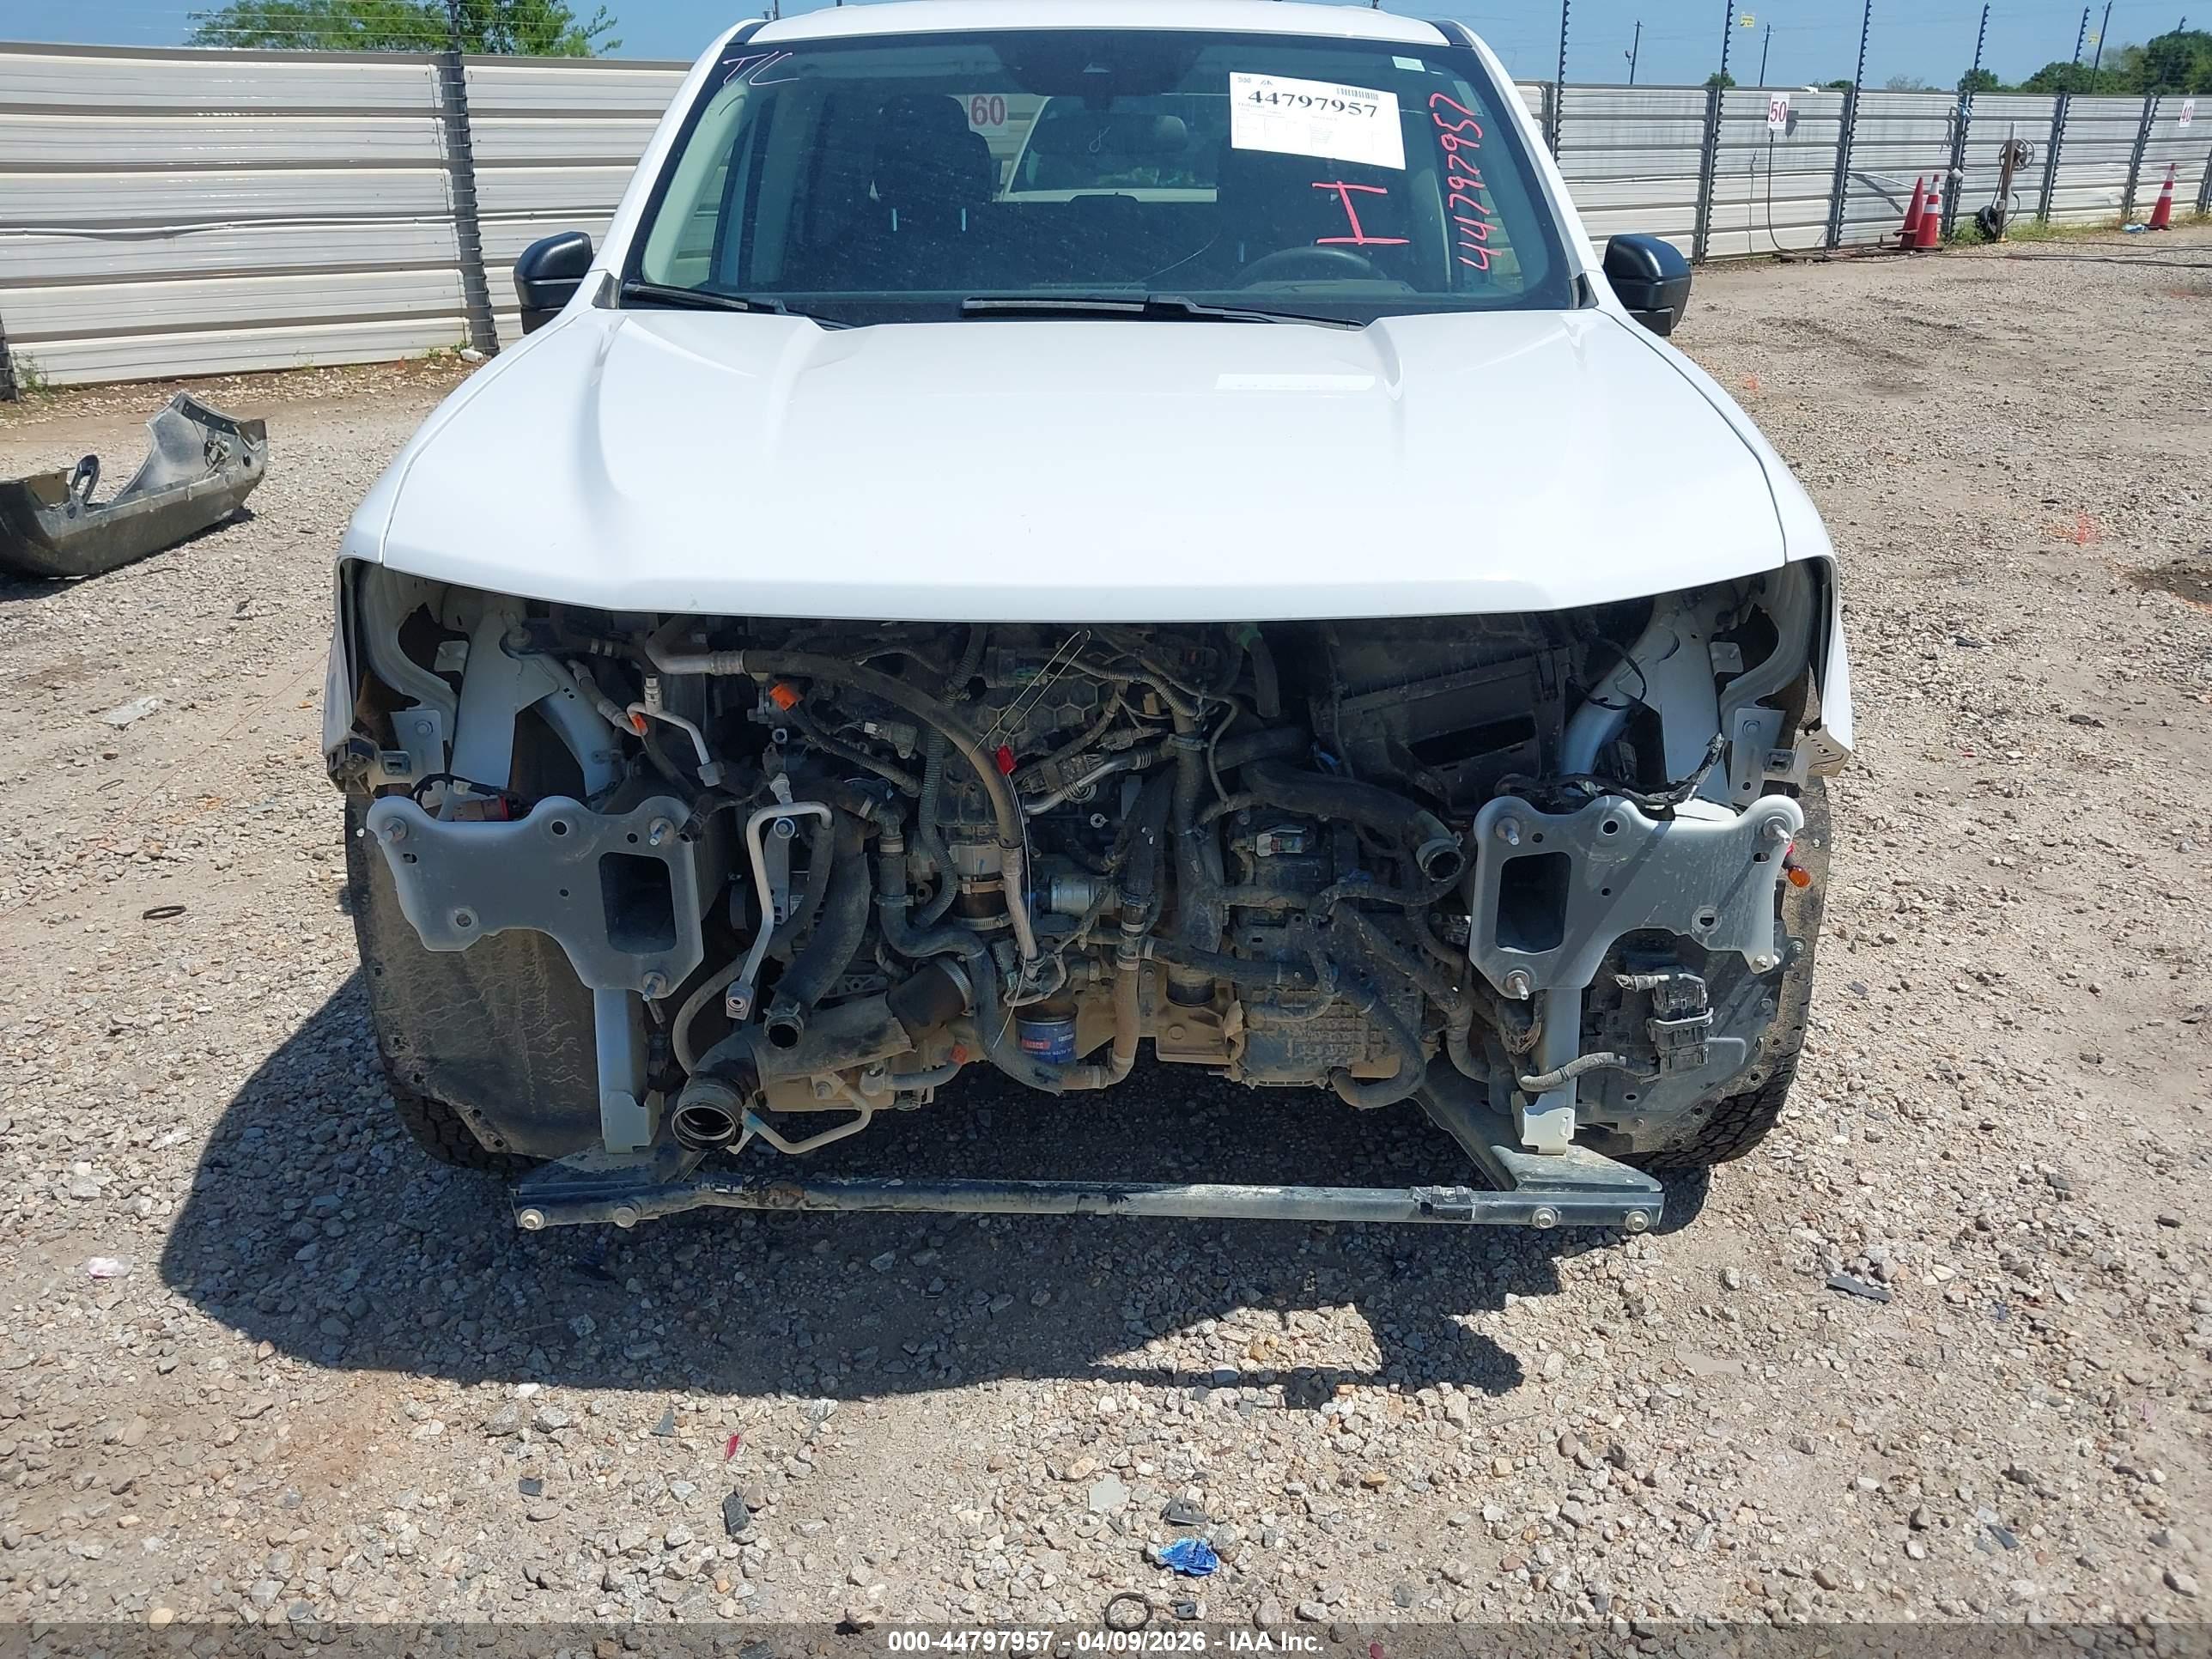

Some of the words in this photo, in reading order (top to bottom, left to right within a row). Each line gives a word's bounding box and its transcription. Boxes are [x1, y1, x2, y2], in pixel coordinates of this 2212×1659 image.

[971, 95, 1005, 125] 60
[1248, 90, 1377, 118] 44797957
[1770, 100, 1787, 122] 50
[1429, 93, 1502, 270] 44797957
